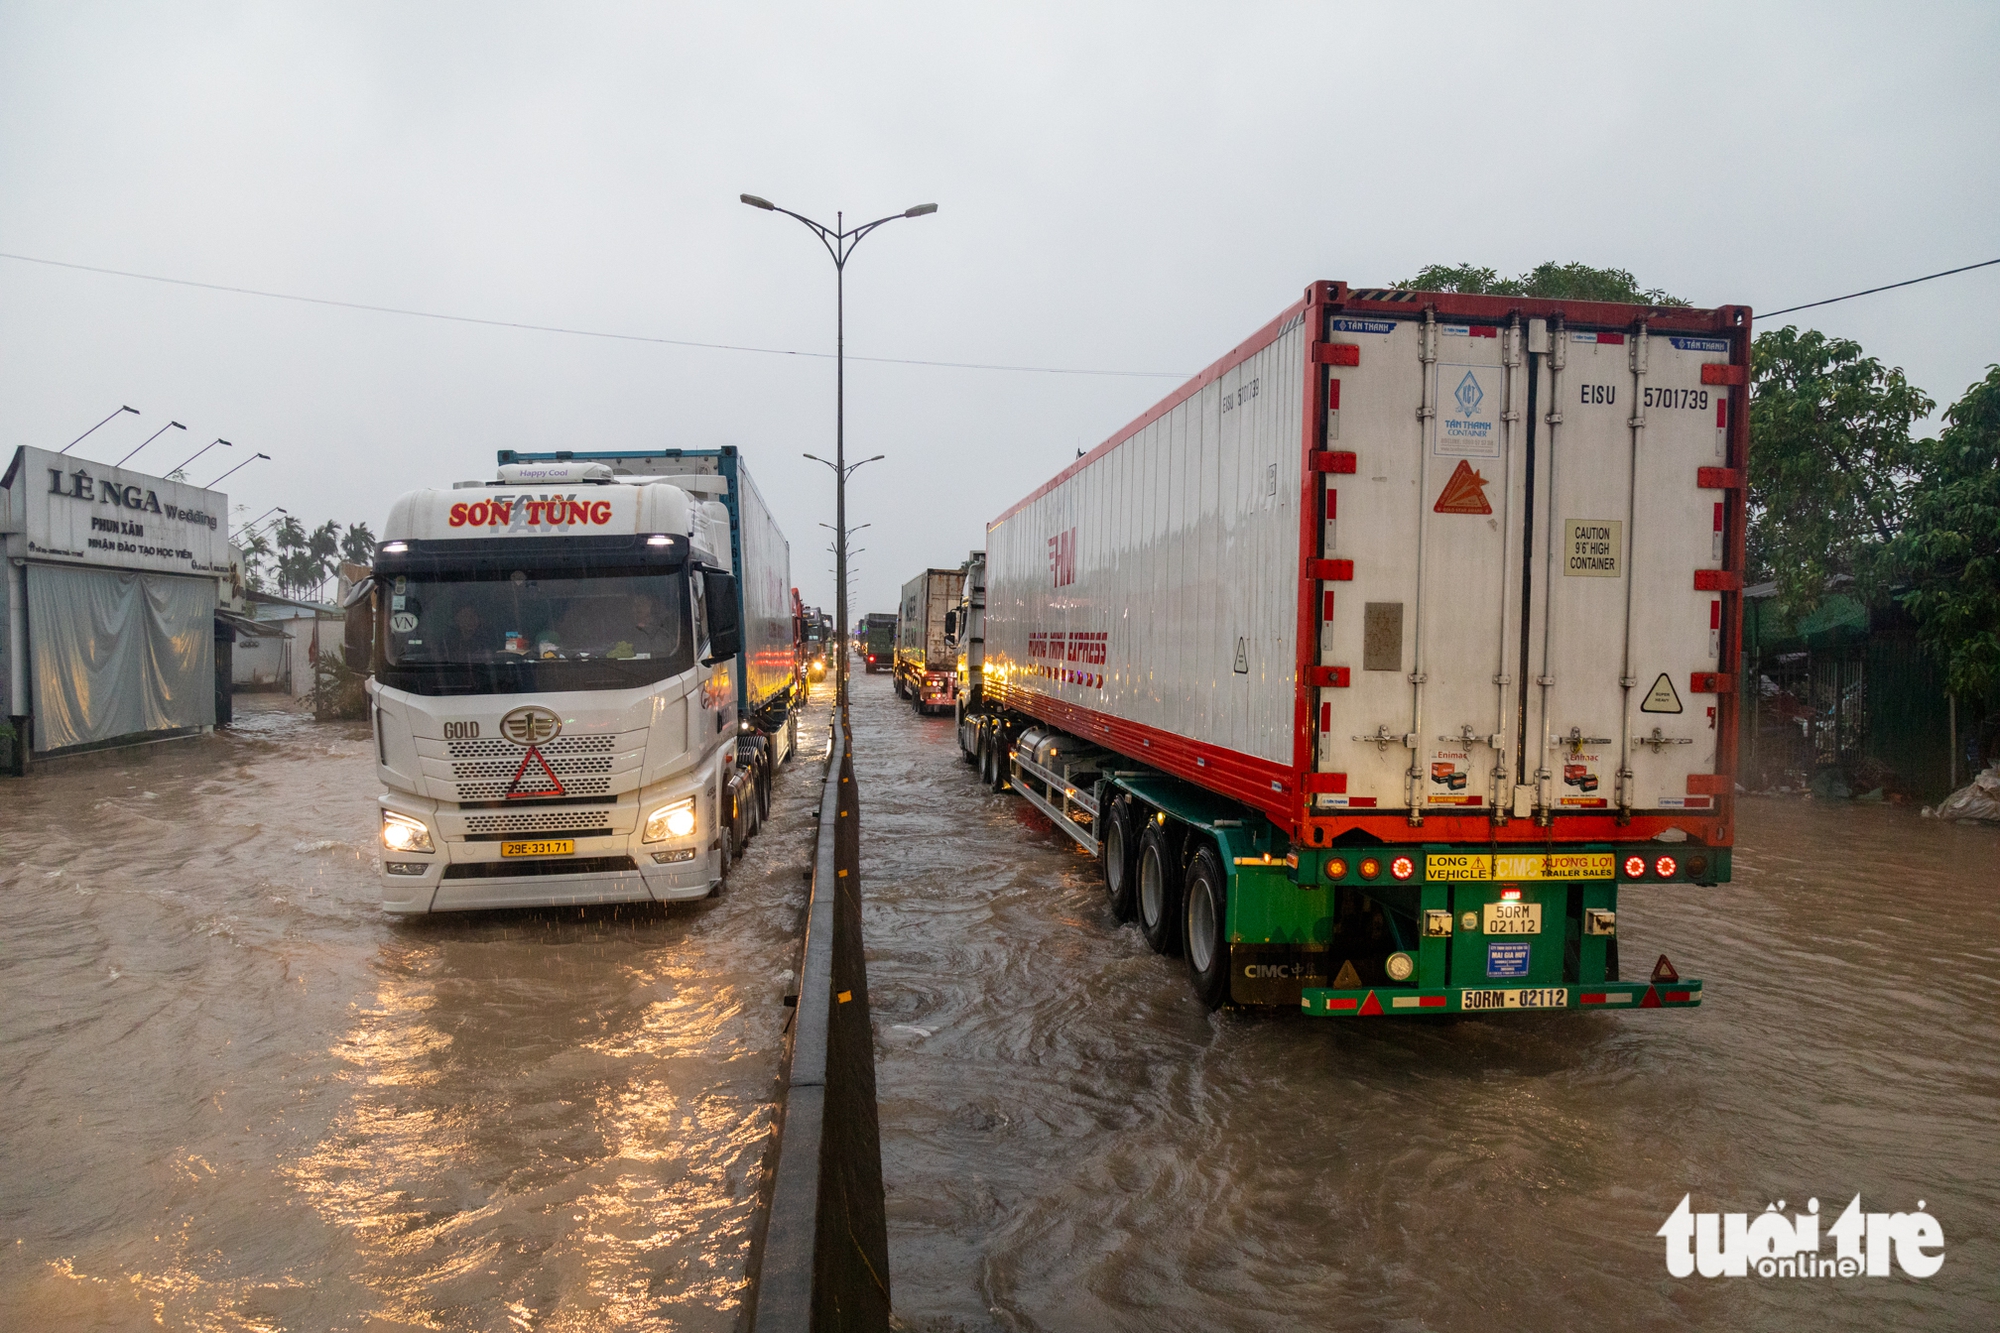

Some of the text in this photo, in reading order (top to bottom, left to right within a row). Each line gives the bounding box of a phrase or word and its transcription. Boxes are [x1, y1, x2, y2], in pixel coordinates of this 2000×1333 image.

[1364, 322, 1389, 332] THANH
[1702, 341, 1724, 350] THANH
[1581, 385, 1708, 409] EISU 5701739
[1445, 419, 1491, 430] TÂN THANH
[1448, 429, 1487, 437] CONTAINER
[520, 469, 568, 478] Happy Cool
[48, 468, 94, 501] LÊ
[99, 479, 162, 514] NGA
[449, 494, 612, 527] SƠN TÙNG
[91, 517, 143, 537] PHUN XĂM
[1575, 526, 1610, 540] CAUTION
[88, 538, 115, 551] NHẬN
[117, 541, 136, 553] ĐÀO
[138, 545, 155, 557] TẠO
[156, 548, 174, 559] HỌC
[1590, 543, 1609, 555] HIGH
[1570, 557, 1615, 570] CONTAINER
[394, 617, 414, 629] VN
[1067, 632, 1108, 665] EXPRESS
[444, 721, 480, 739] GOLD
[1429, 857, 1467, 866] LONG
[1497, 857, 1538, 877] CIMC
[1428, 870, 1487, 879] VEHICLE
[1496, 906, 1530, 919] 50RM
[1490, 920, 1535, 933] 021.12
[1244, 965, 1288, 978] CIMC
[1464, 991, 1504, 1008] 50RM
[1519, 989, 1565, 1007] 02112
